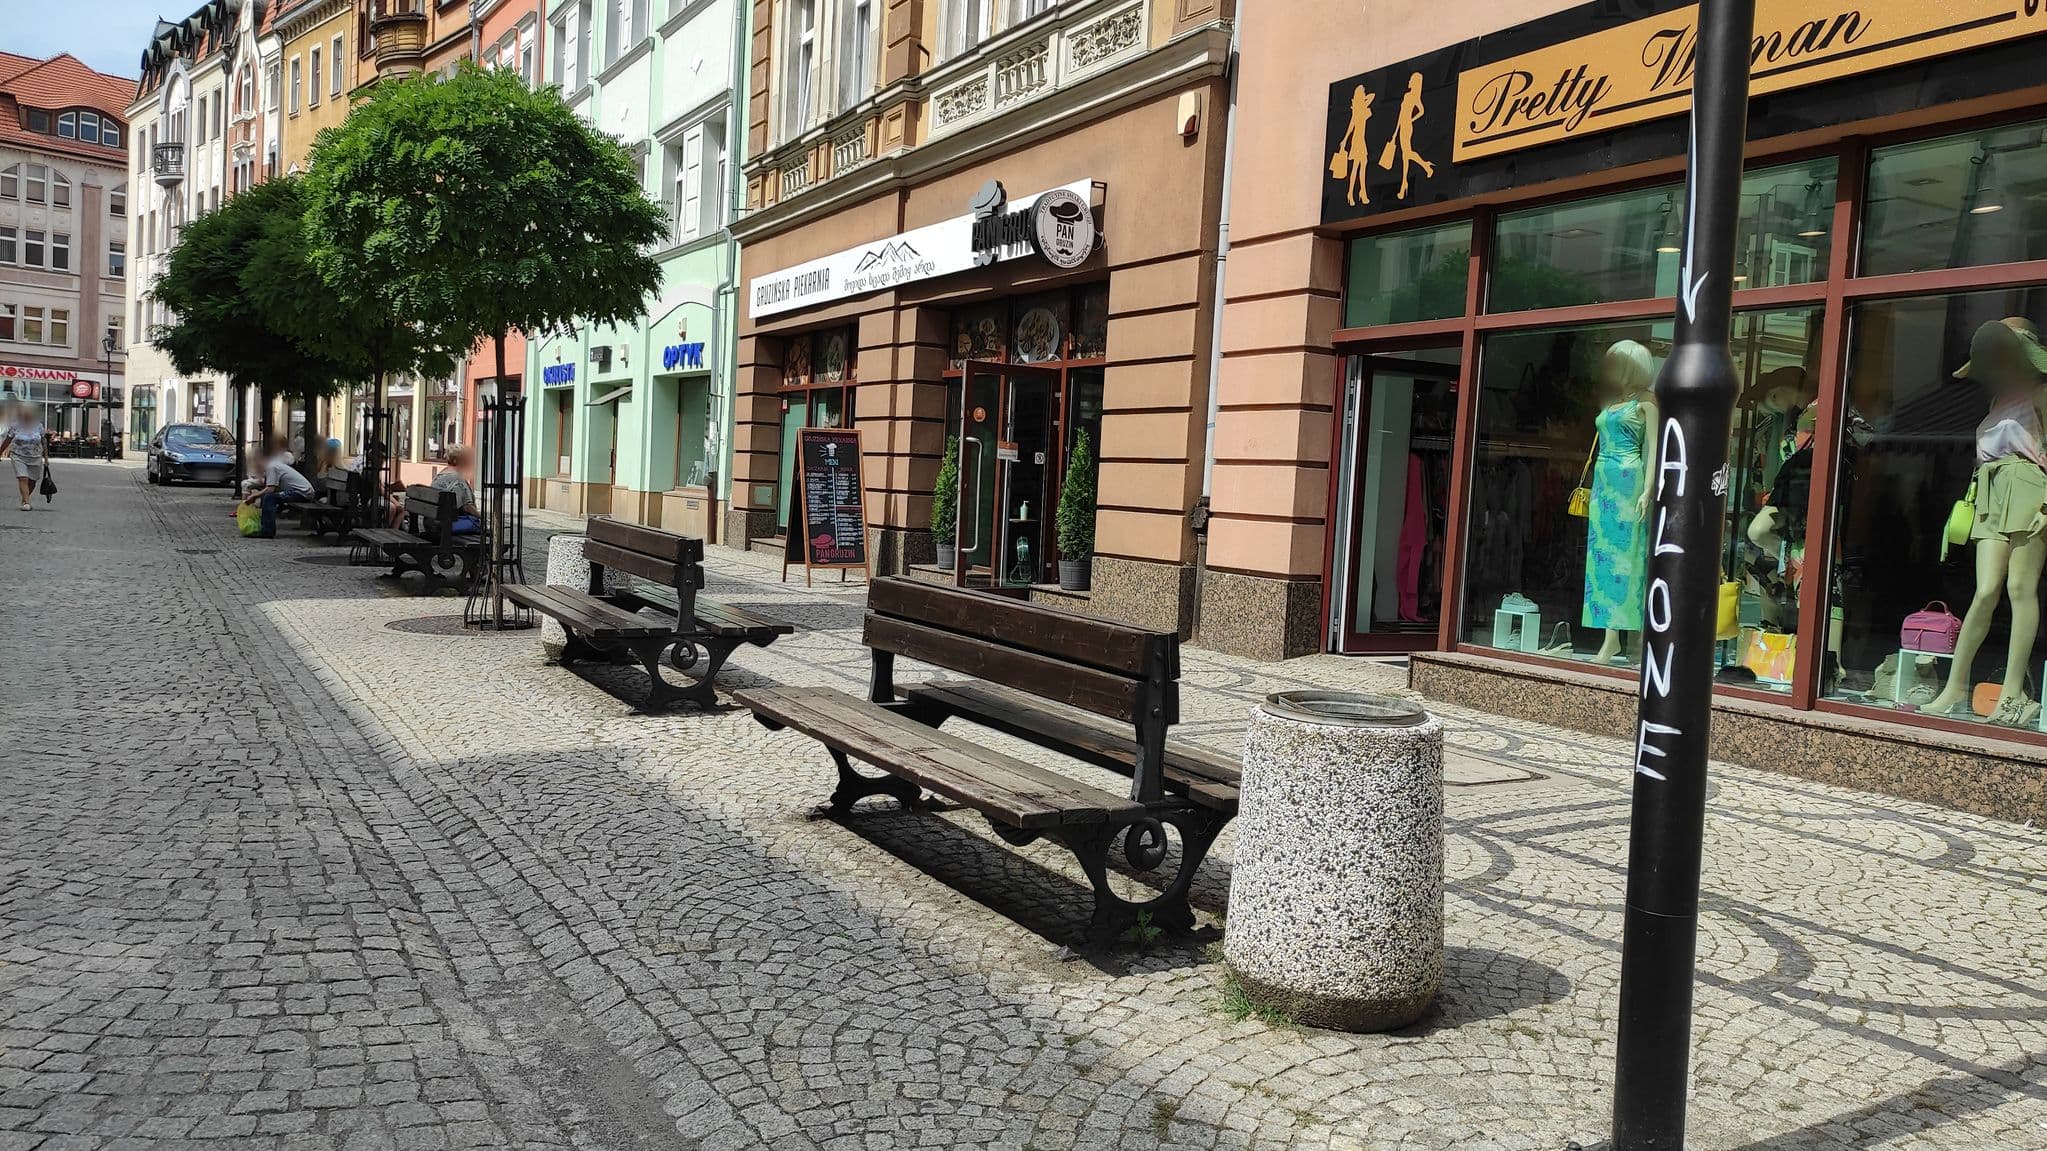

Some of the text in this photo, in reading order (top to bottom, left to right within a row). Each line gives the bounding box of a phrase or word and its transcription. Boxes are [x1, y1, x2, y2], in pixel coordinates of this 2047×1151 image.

[1469, 10, 1873, 133] Pretty Wman
[1056, 224, 1075, 241] PAN
[756, 267, 830, 307] GRUZIŃSKA PIEKARNIA
[663, 342, 705, 370] OPTYK
[815, 548, 856, 560] PAN GRUZIN
[1635, 416, 1689, 782] ALONE
